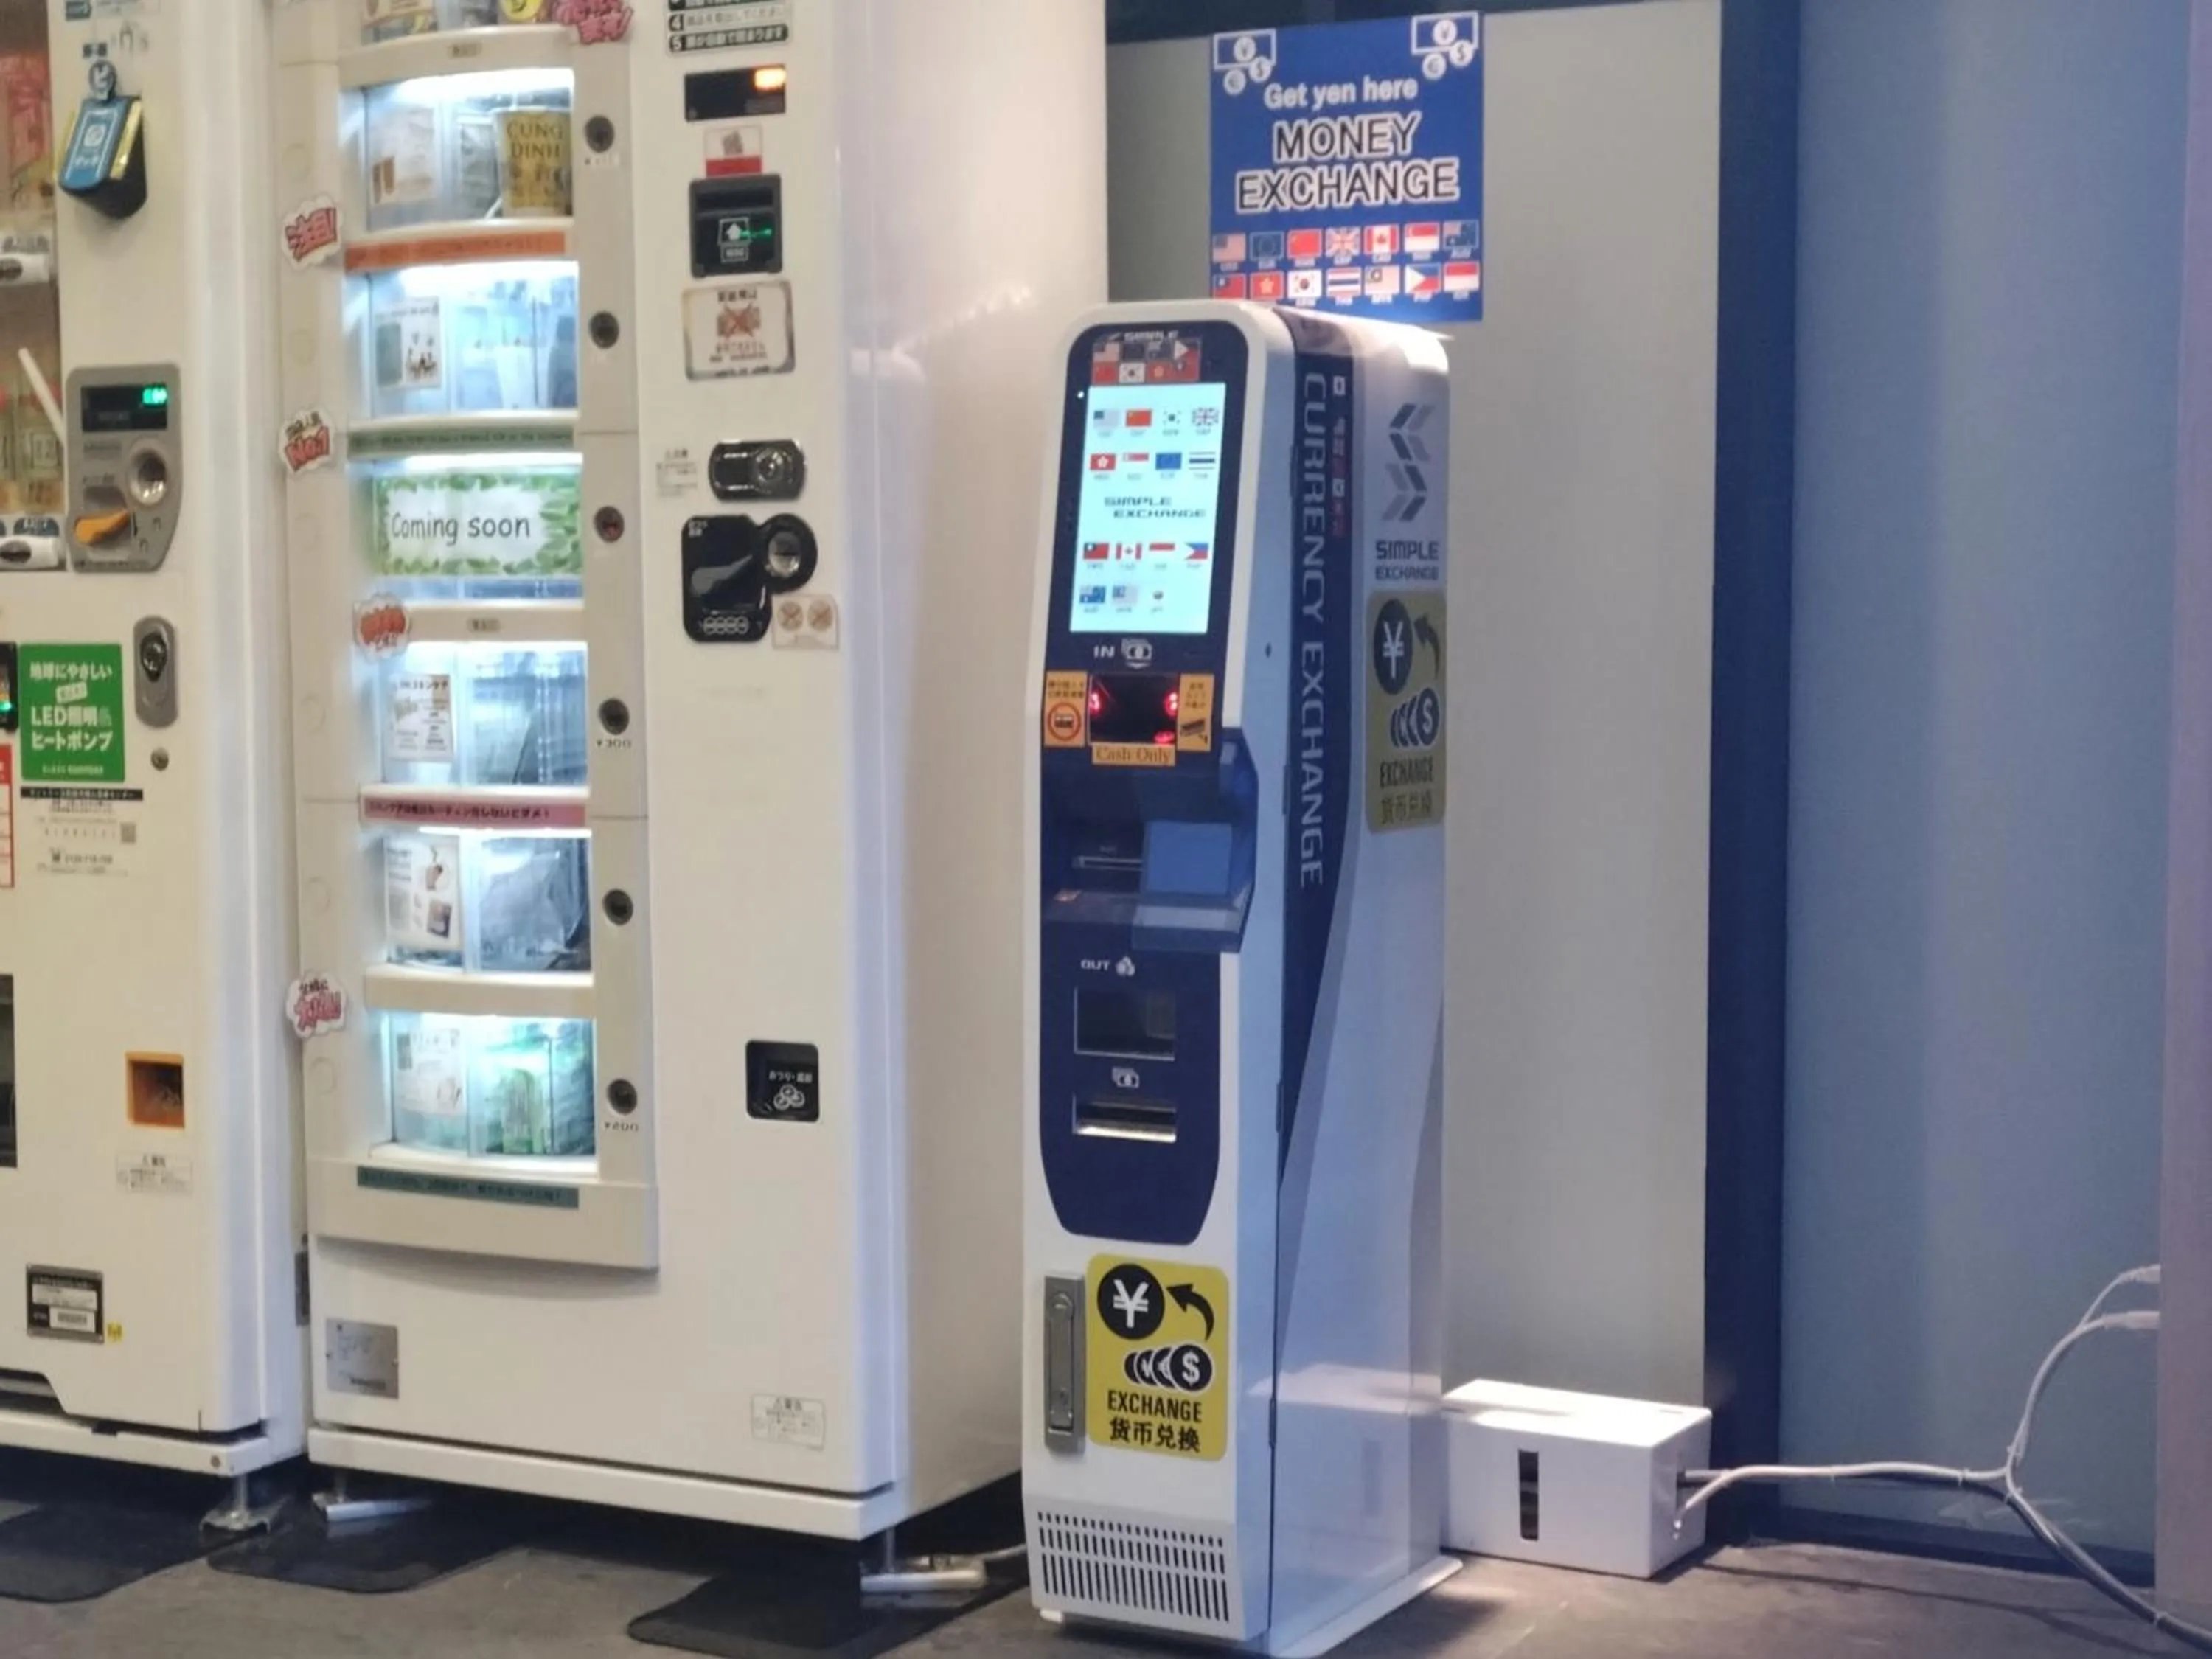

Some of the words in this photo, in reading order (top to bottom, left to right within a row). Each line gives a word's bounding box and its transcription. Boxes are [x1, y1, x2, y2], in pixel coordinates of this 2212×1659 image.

[1265, 81, 1307, 109] Get
[1313, 83, 1355, 111] yen
[1364, 75, 1419, 101] here
[1273, 111, 1422, 163] MONEY
[1236, 157, 1460, 214] EXCHANGE
[1105, 497, 1172, 507] SIMPLE
[1301, 372, 1328, 624] CURRENCY
[392, 511, 458, 546] Coming
[467, 517, 530, 538] soon
[1375, 540, 1439, 561] SIMPLE
[1375, 566, 1439, 581] EXCHANGE
[1093, 645, 1115, 658] IN
[1096, 746, 1131, 762] Cash
[1136, 747, 1170, 764] Only
[1299, 641, 1324, 888] EXCHANGE
[1379, 755, 1434, 789] EXCHANGE
[1080, 959, 1110, 972] OUT
[1107, 1389, 1203, 1423] EXCHANGE
[1109, 1416, 1201, 1453] 货币兑换
